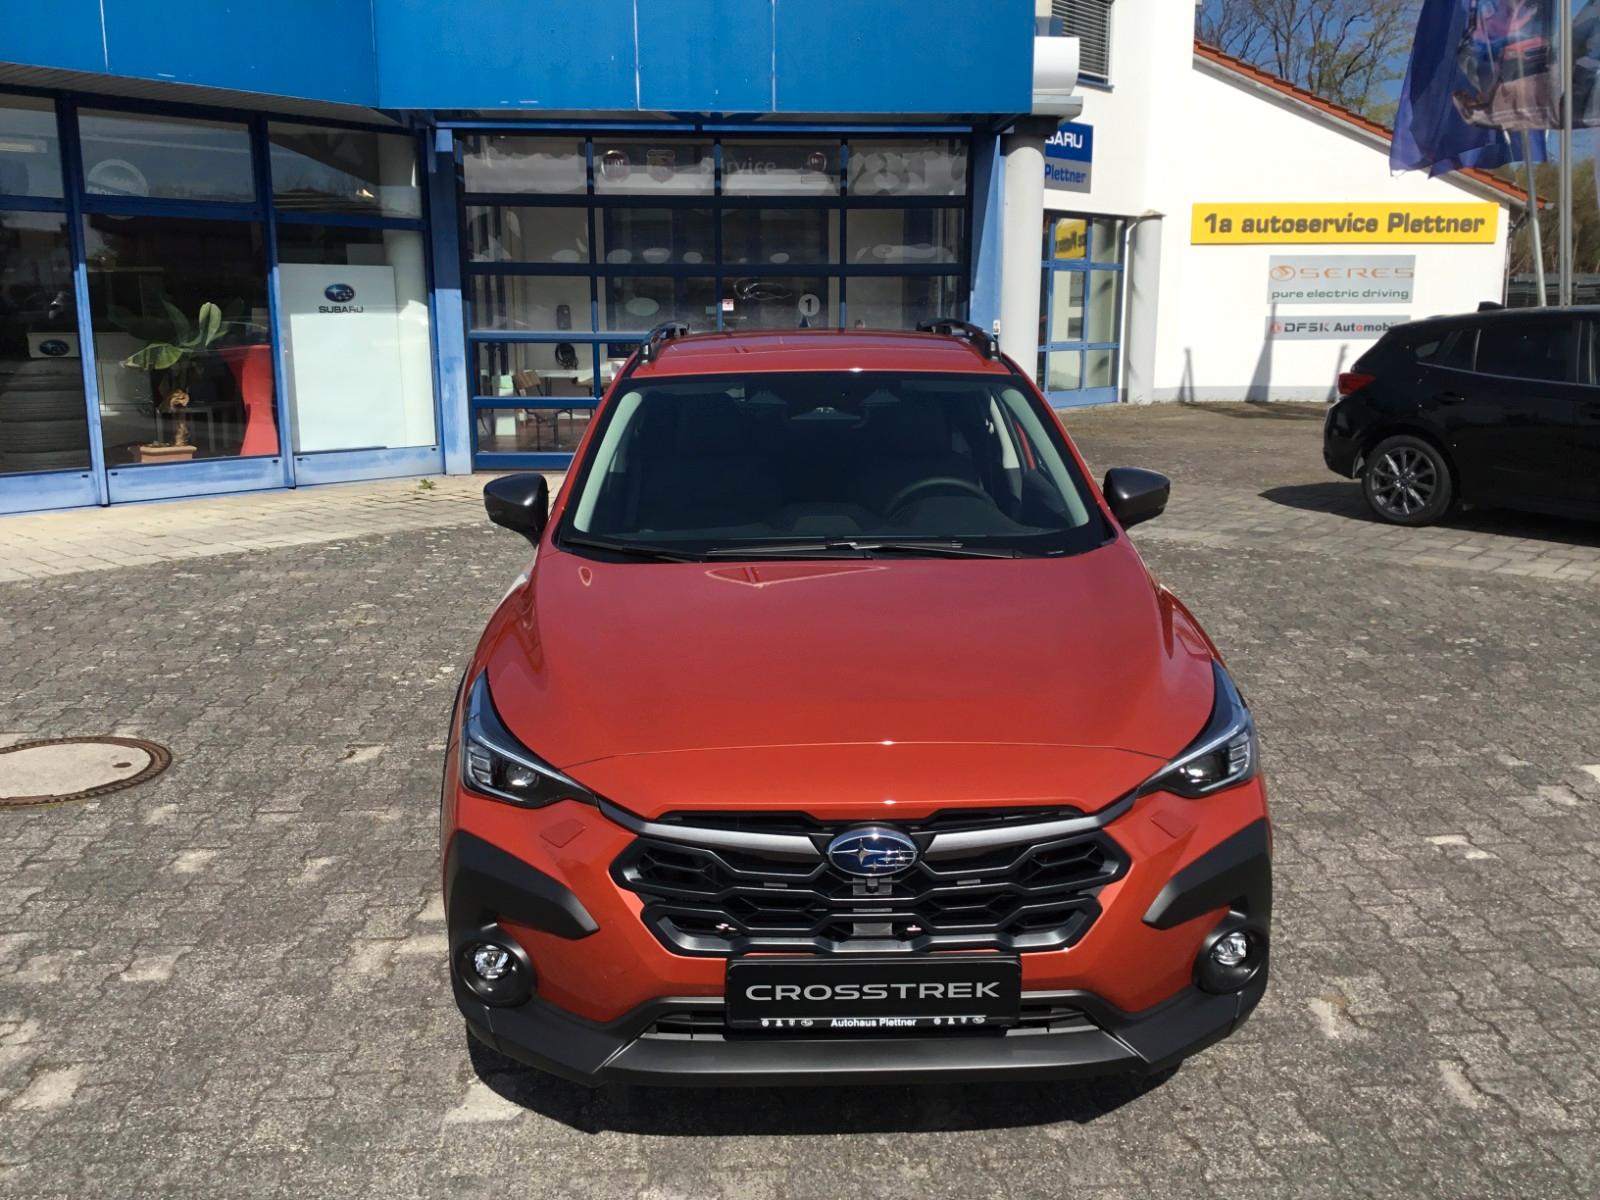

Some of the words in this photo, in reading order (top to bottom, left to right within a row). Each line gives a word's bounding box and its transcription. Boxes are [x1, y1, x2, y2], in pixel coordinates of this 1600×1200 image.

[701, 156, 777, 176] Srvice
[1045, 163, 1087, 184] Plettner
[1204, 213, 1232, 234] 1a
[1241, 212, 1378, 233] autoservice
[1387, 212, 1485, 233] Plettner
[1300, 267, 1414, 279] SERES
[1272, 291, 1304, 300] pure
[1306, 289, 1359, 299] electric
[1362, 289, 1409, 300] driving
[318, 305, 364, 314] SUBARU
[1284, 323, 1330, 333] DFSK
[745, 982, 1001, 1001] CROSSTREK
[830, 1018, 877, 1028] Autohaus
[879, 1017, 918, 1028] Plettner
